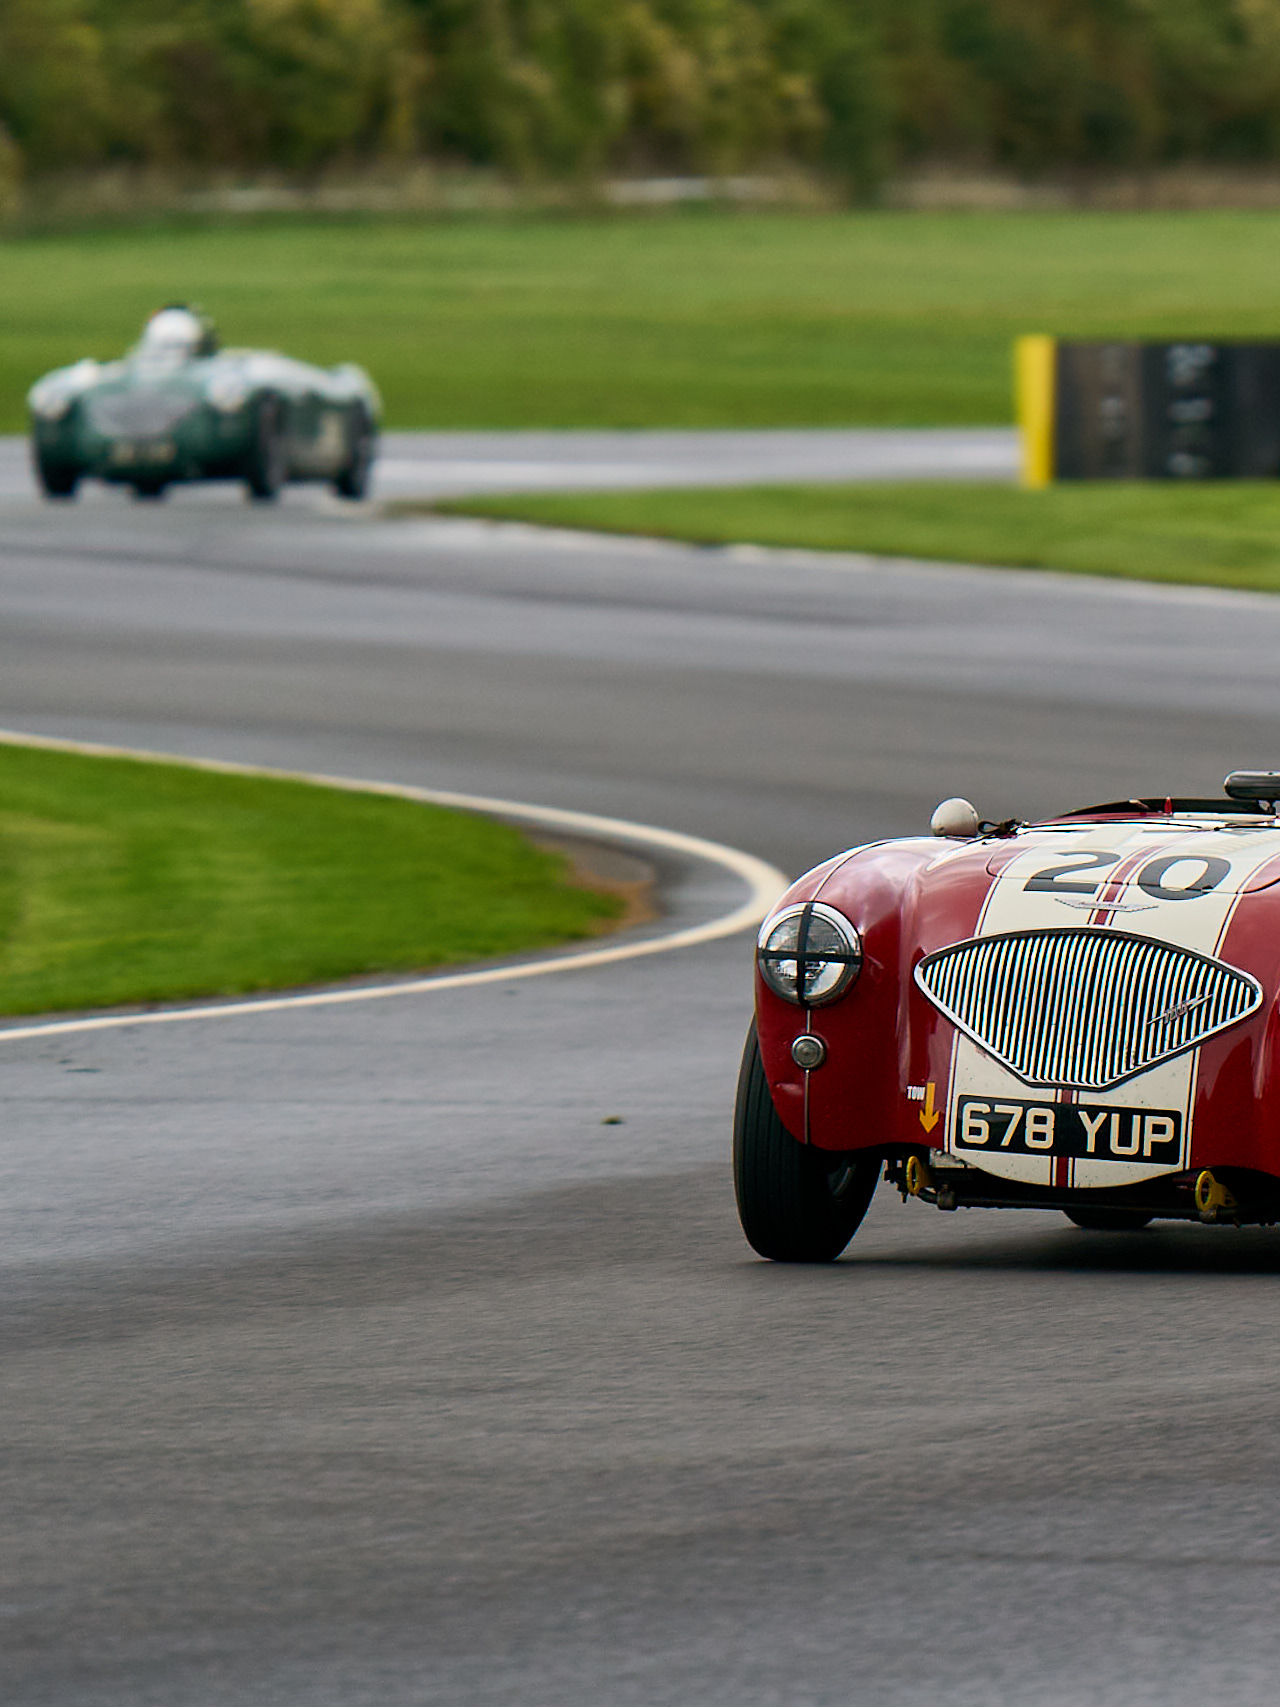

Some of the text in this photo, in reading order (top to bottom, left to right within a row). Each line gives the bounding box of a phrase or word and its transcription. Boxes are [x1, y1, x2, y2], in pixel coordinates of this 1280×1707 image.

[1022, 850, 1231, 901] 20
[907, 1085, 926, 1101] TOW
[962, 1102, 1174, 1157] 678 YUP
